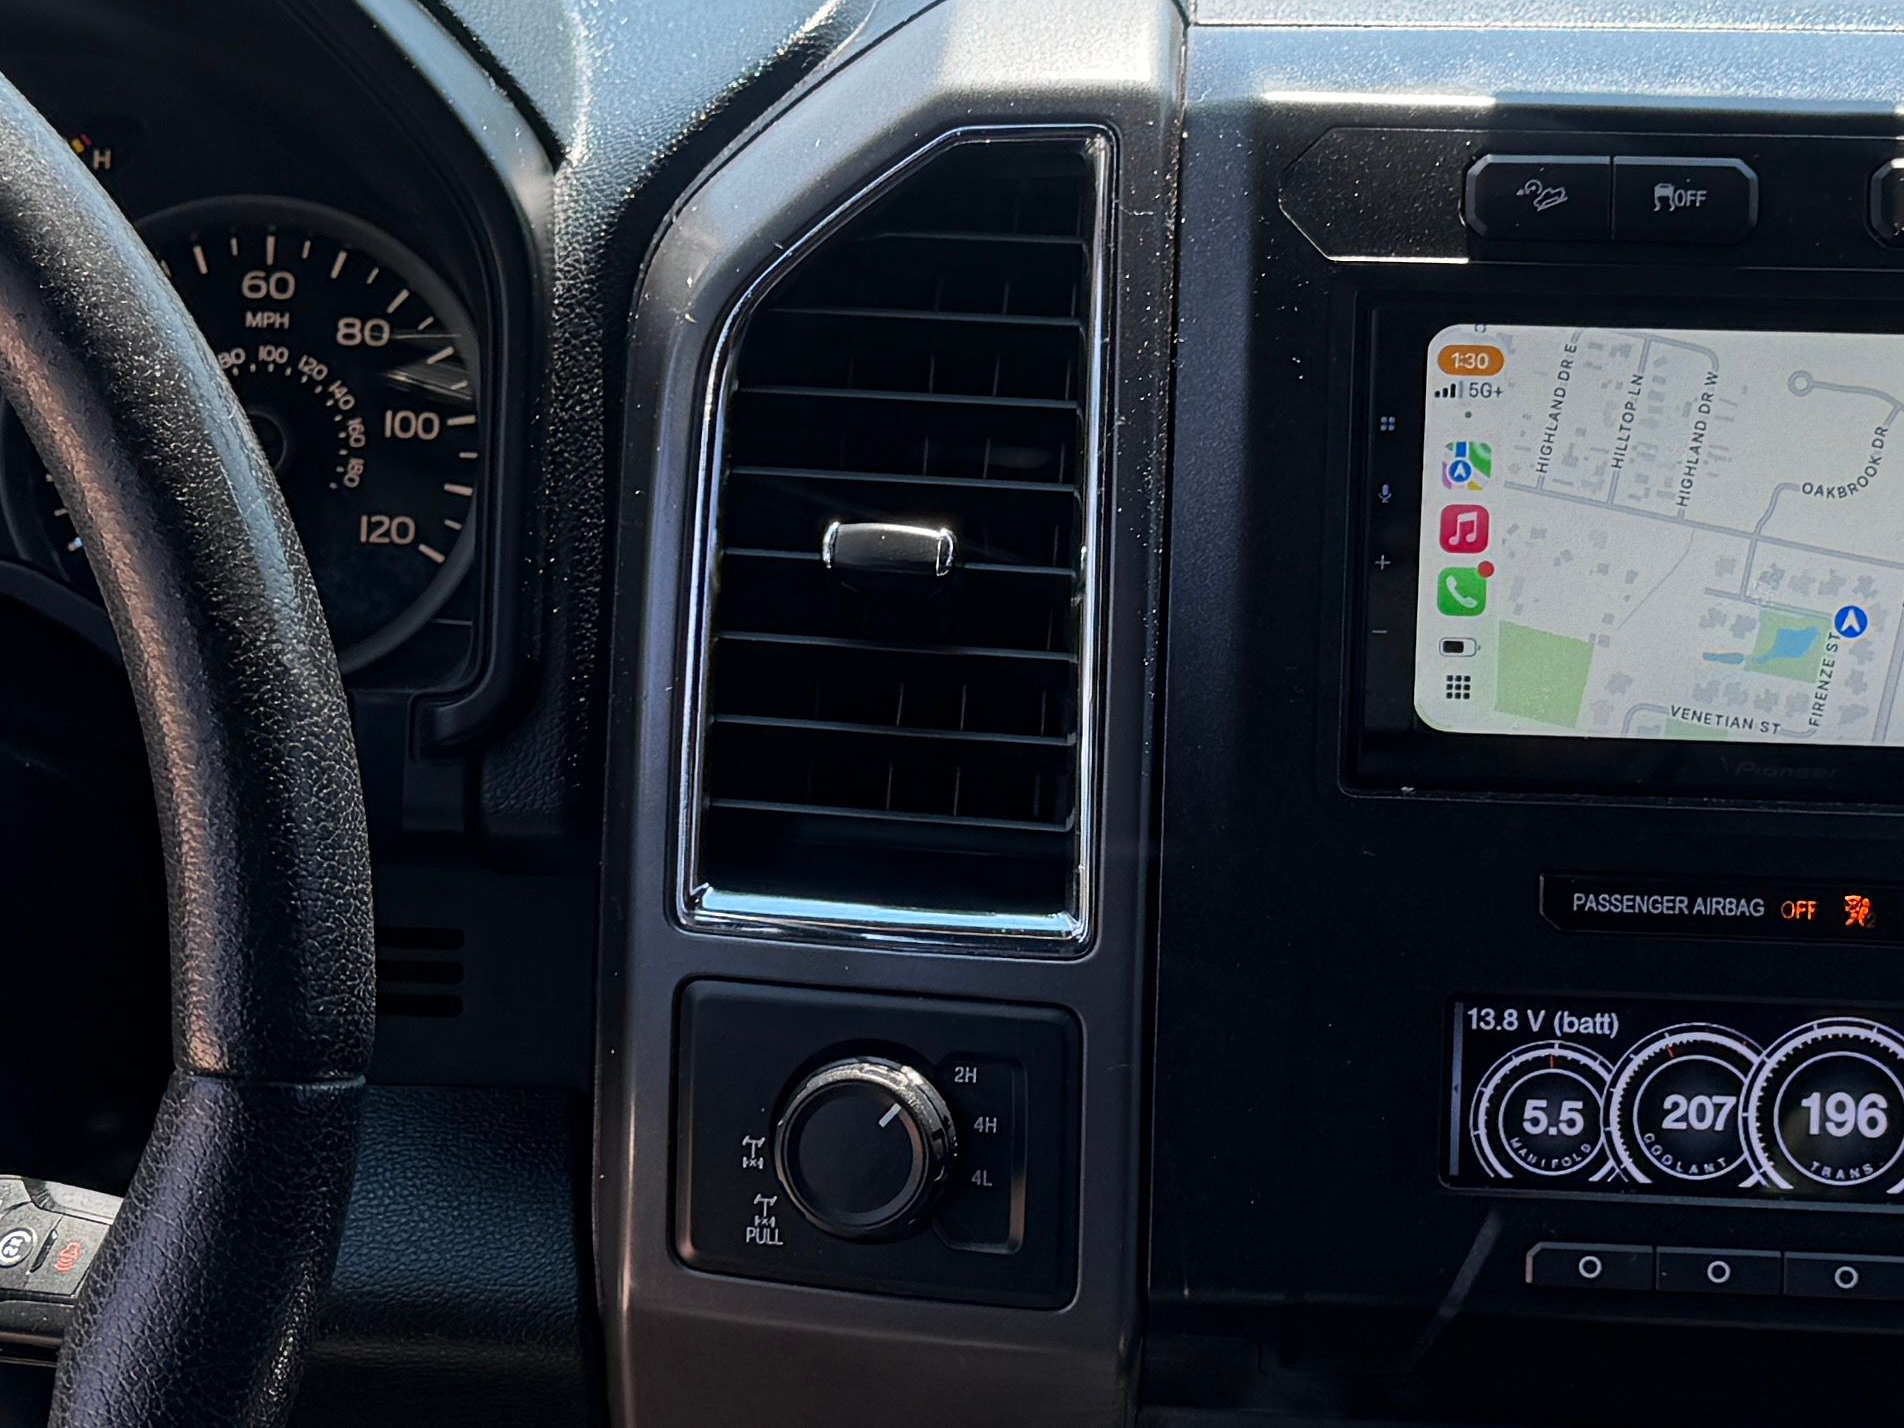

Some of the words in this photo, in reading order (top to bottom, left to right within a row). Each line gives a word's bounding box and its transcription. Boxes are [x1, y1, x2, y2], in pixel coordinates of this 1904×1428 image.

[93, 148, 112, 170] H
[1674, 189, 1708, 208] OFF
[241, 270, 296, 300] 60
[245, 311, 290, 329] MPH
[336, 318, 391, 347] 80
[258, 345, 290, 364] 100
[1451, 352, 1490, 370] 1:30
[1564, 344, 1577, 353] E
[298, 354, 328, 381] 120
[1557, 359, 1574, 382] DR
[1704, 371, 1719, 387] W
[1468, 381, 1504, 399] 5G+
[1698, 391, 1714, 415] DR
[384, 410, 441, 441] 100
[1535, 387, 1566, 473] HIGHLAND
[1611, 402, 1636, 469] HILLTOP
[1629, 374, 1644, 396] LN
[1677, 420, 1707, 507] HIGHLAND
[1801, 452, 1883, 500] OAKBROOK
[1871, 425, 1889, 453] DR
[359, 514, 416, 545] 120
[1809, 658, 1836, 727] FIRENZE
[1826, 632, 1841, 653] ST
[1670, 704, 1754, 730] VENETIAN
[1760, 720, 1782, 735] ST
[1572, 891, 1689, 916] PASSENGER
[1692, 896, 1766, 918] AIRBAG
[1781, 900, 1818, 921] OFF
[1467, 1007, 1519, 1032] 13.8
[1526, 1009, 1546, 1032] V
[1553, 1010, 1619, 1039] (batt)
[954, 1066, 977, 1085] 2H
[973, 1116, 998, 1135] 4H
[1522, 1098, 1585, 1136] 5.5
[1661, 1094, 1737, 1131] 207
[1800, 1091, 1889, 1139] 196
[1509, 1137, 1592, 1170] MANIFOLD
[1642, 1132, 1728, 1176] COOLANT
[971, 1170, 993, 1188] 4L
[745, 1227, 784, 1246] PULL
